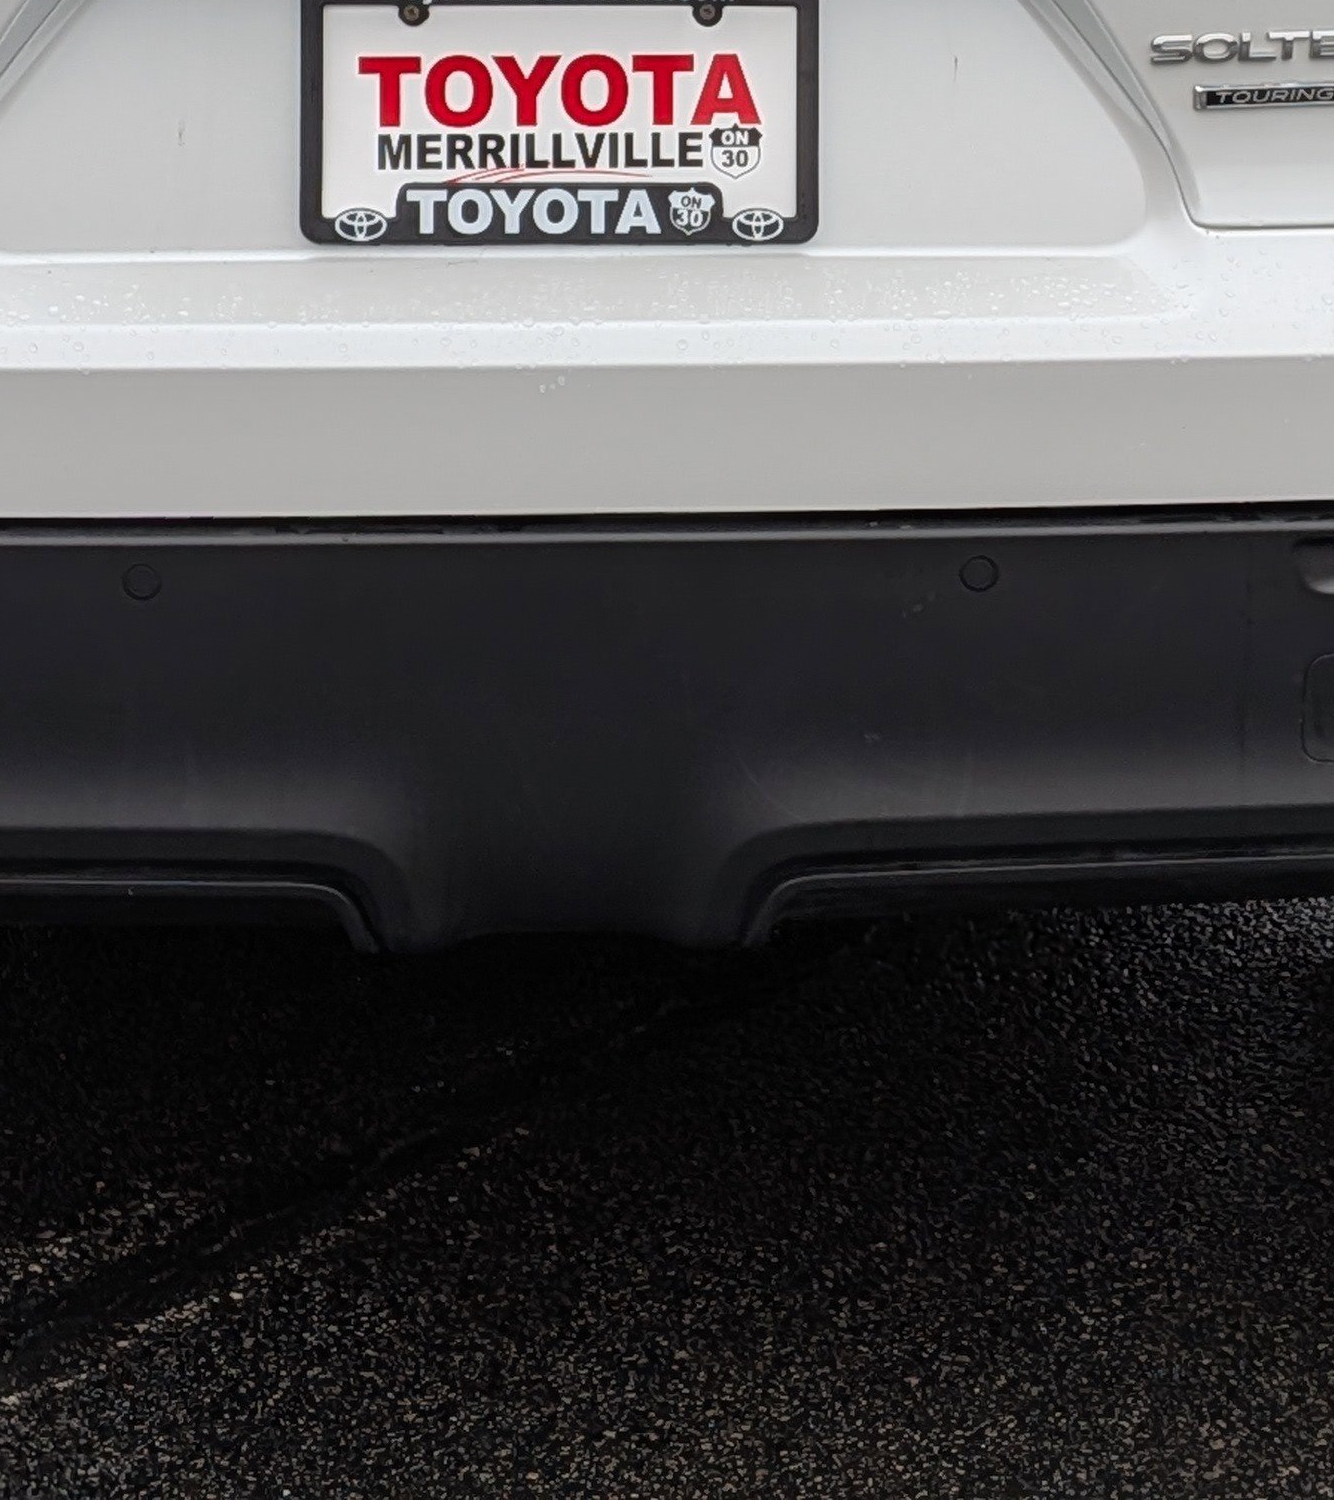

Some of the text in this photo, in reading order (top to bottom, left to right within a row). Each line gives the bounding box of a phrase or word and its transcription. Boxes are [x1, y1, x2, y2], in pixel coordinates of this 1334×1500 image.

[357, 53, 763, 128] TOYOTA
[1215, 87, 1334, 105] TOURING
[720, 130, 750, 147] ON
[377, 131, 705, 171] MERRILLVILLE
[720, 149, 750, 169] 30
[406, 188, 662, 235] TOYOTA
[679, 195, 704, 210] ON
[676, 208, 704, 228] 30
